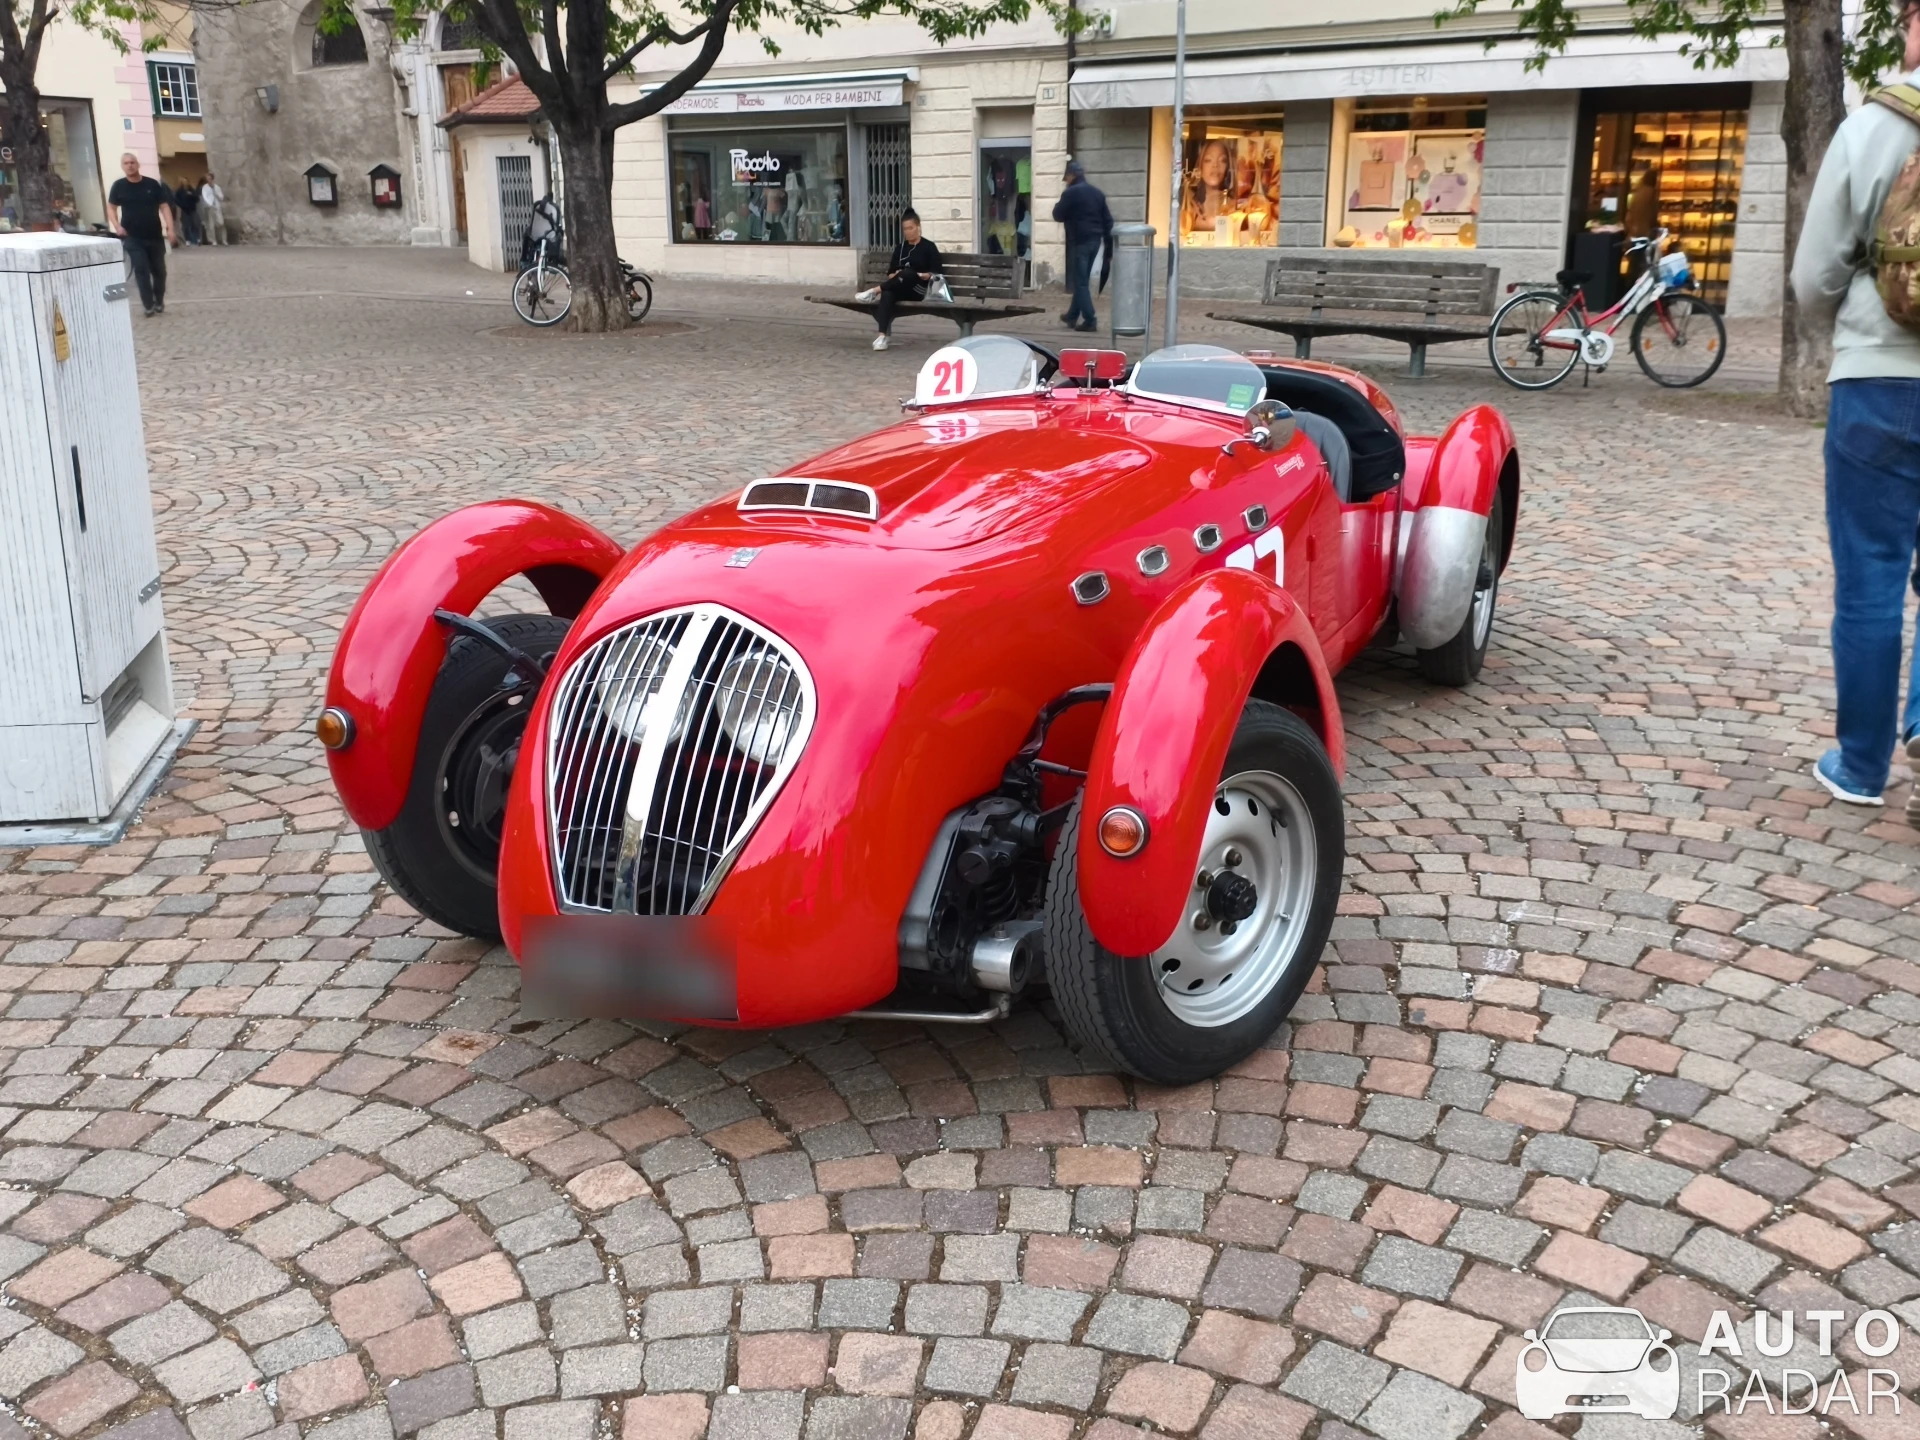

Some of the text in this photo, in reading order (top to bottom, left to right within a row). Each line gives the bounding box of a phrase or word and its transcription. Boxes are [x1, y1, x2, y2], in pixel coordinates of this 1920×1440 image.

[784, 94, 812, 106] MODA
[815, 93, 832, 104] PER
[835, 91, 881, 103] BAMBINI
[1428, 217, 1461, 225] CHANEL
[933, 359, 964, 397] 21
